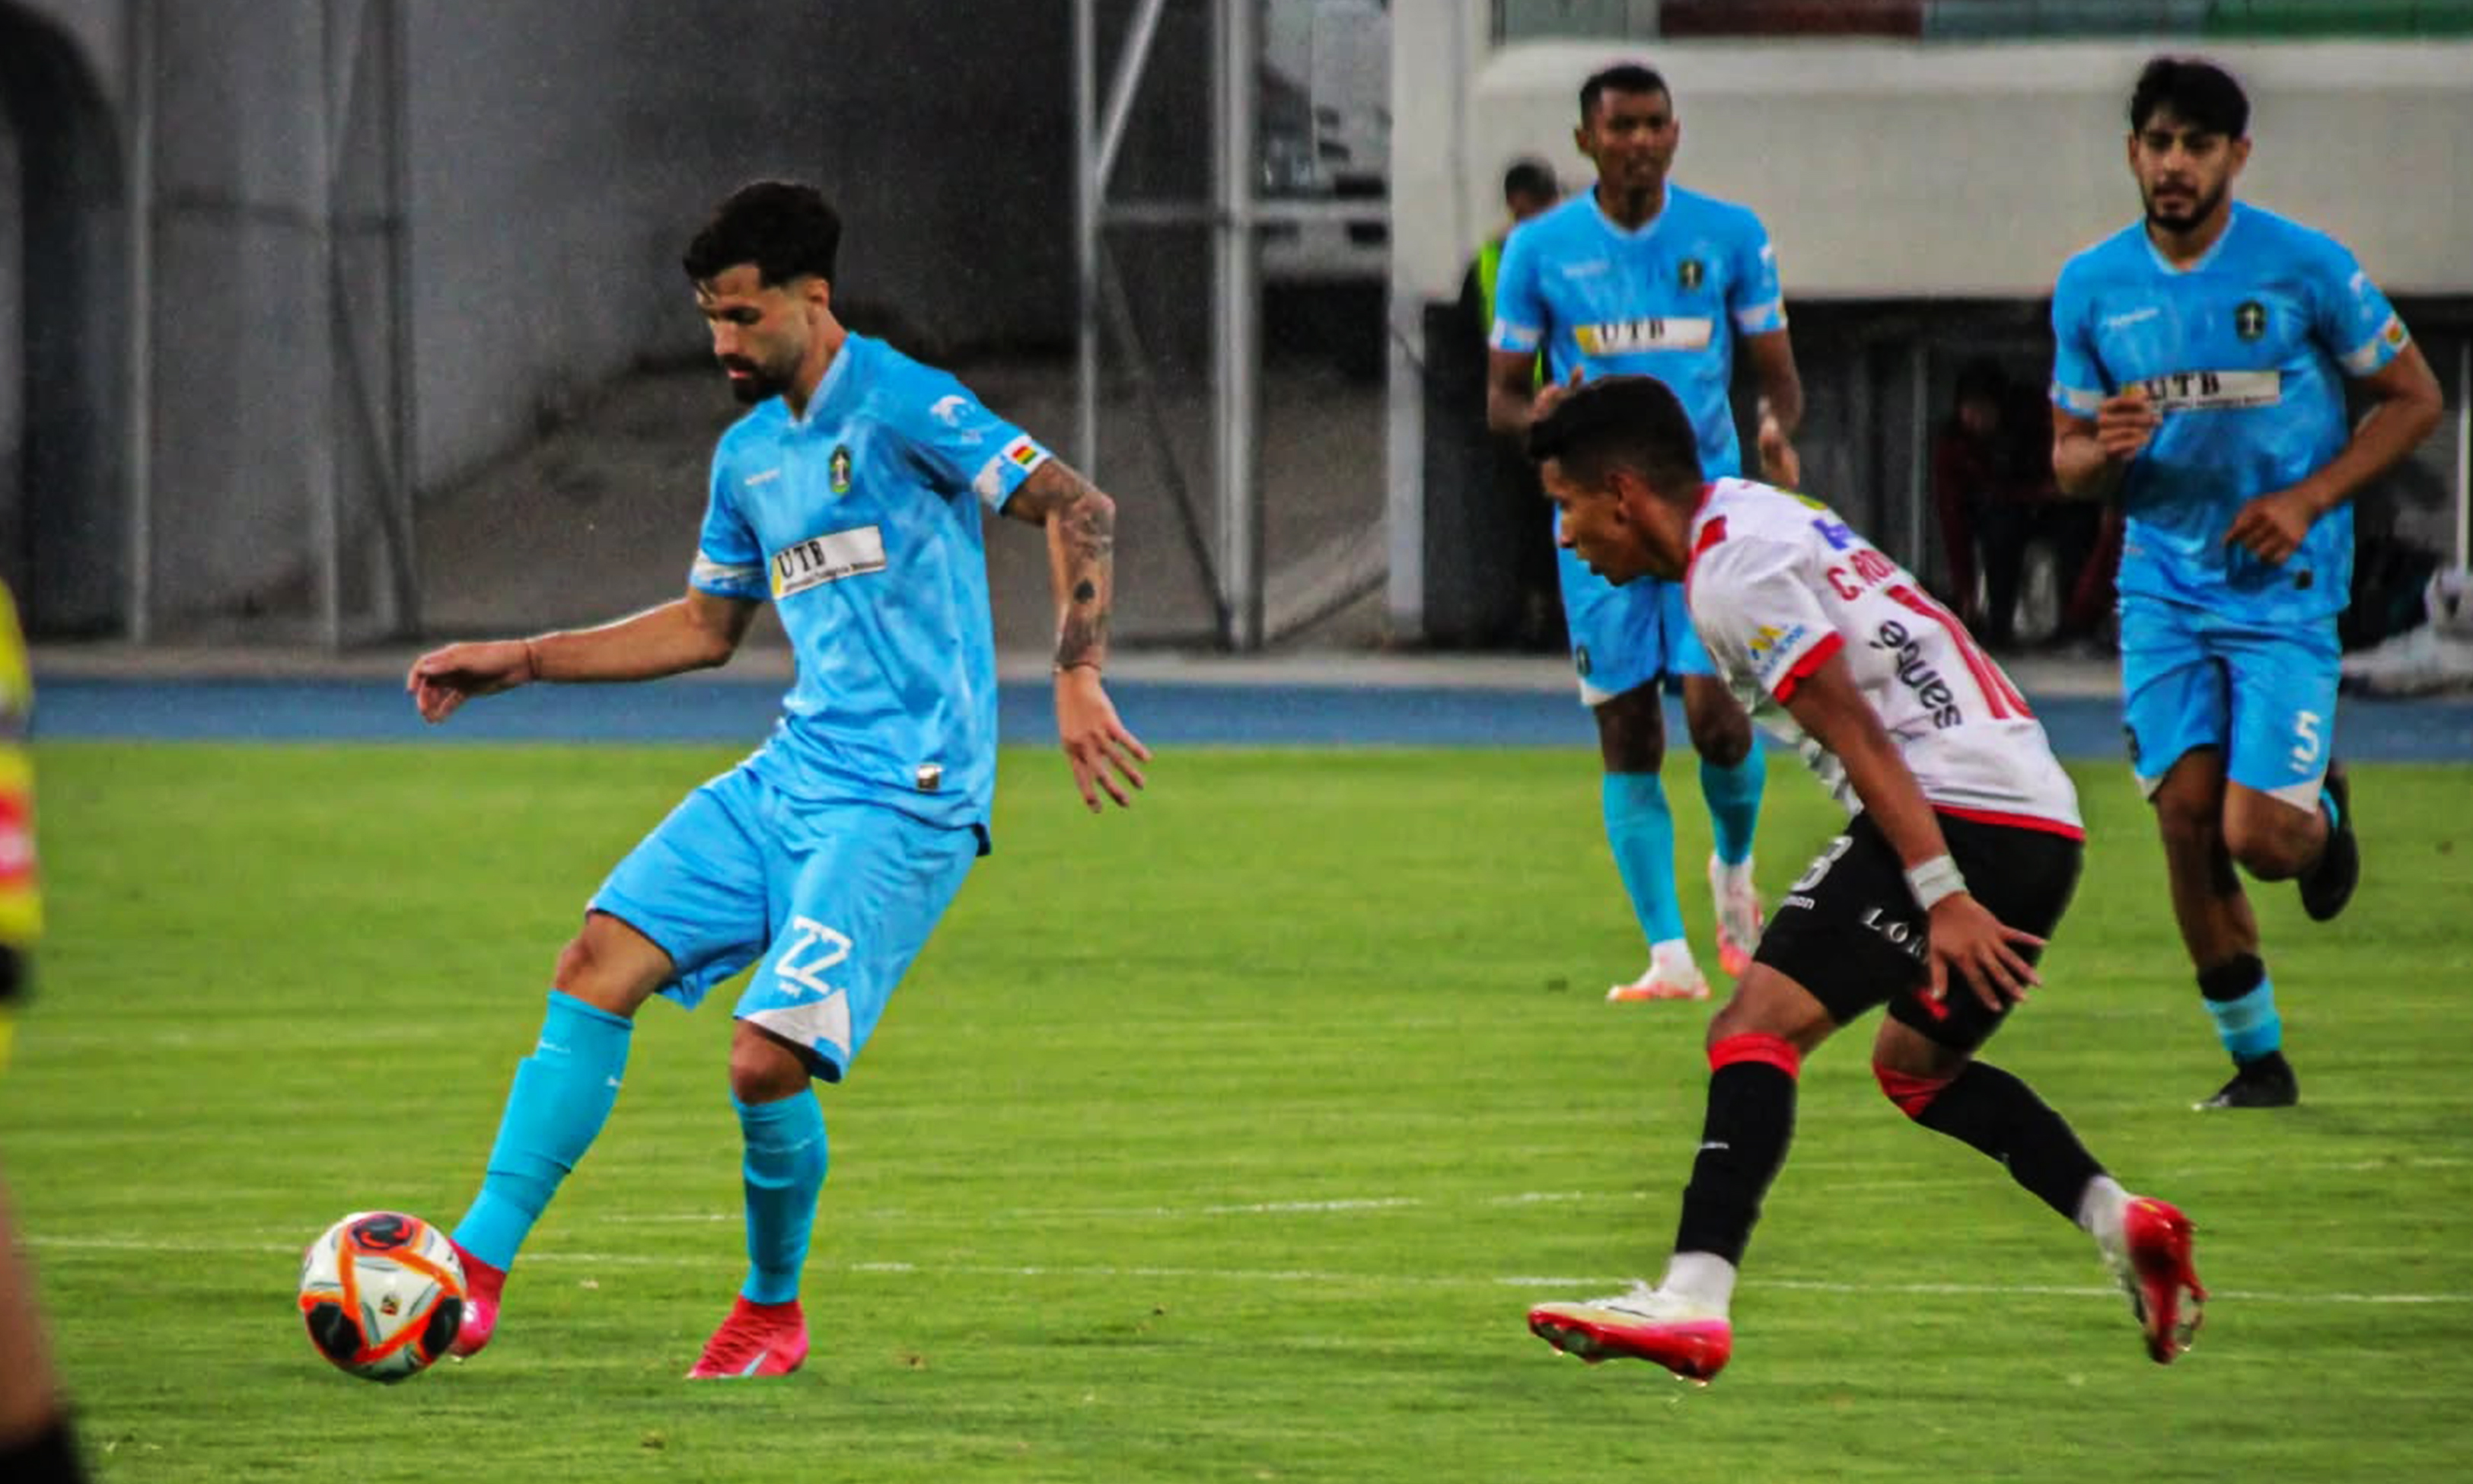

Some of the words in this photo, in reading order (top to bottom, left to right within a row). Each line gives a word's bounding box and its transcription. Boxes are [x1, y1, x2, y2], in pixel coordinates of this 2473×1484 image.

[1601, 318, 1665, 344] UTB
[778, 540, 825, 578] UTB
[2293, 709, 2321, 763] 5
